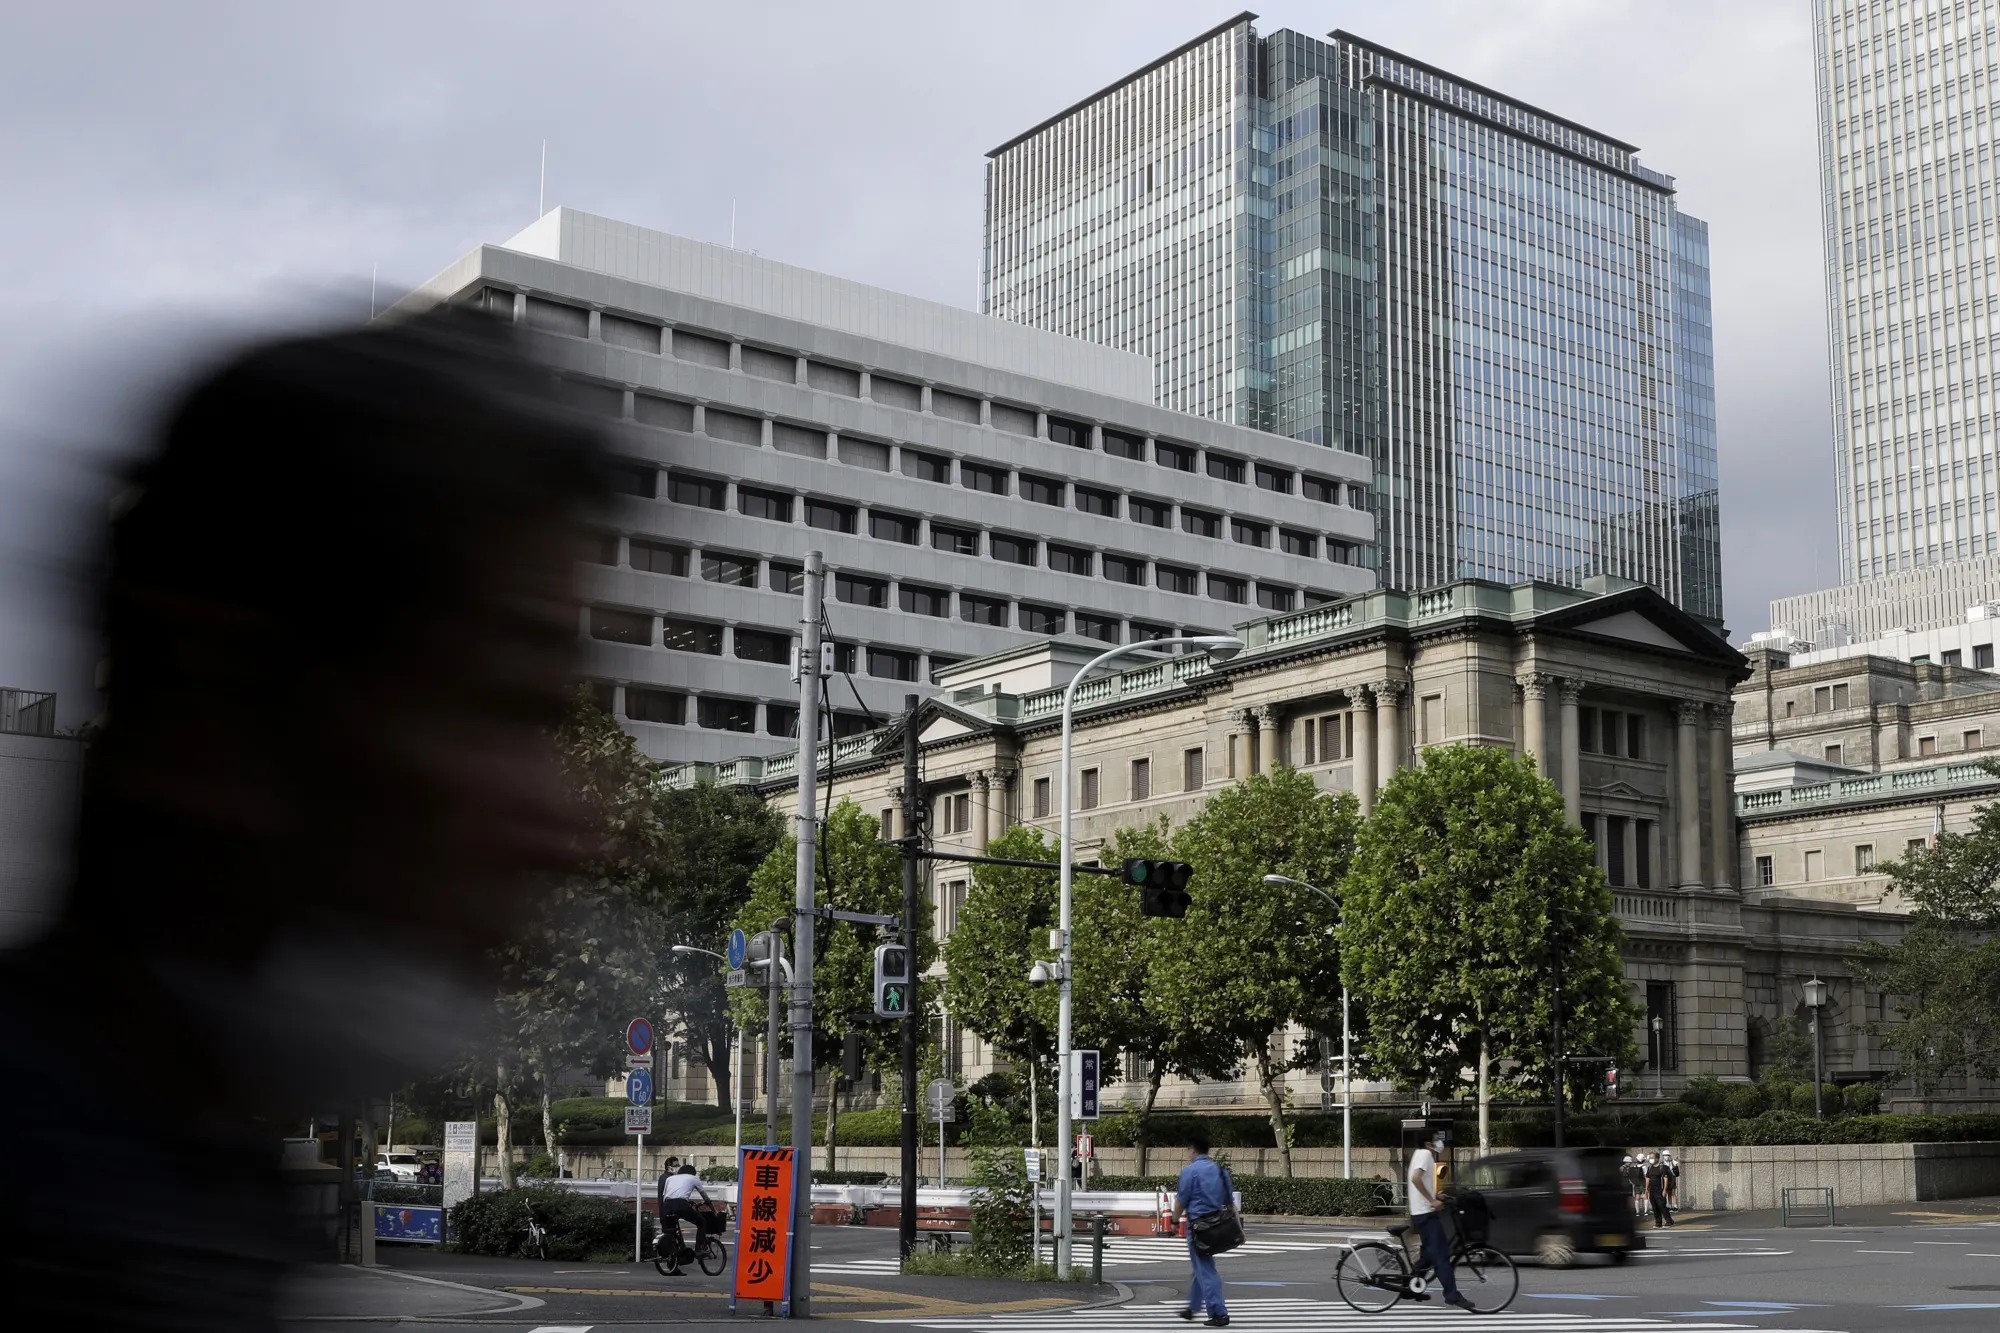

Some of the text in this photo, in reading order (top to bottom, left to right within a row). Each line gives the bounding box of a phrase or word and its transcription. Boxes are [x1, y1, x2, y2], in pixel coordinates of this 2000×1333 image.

[632, 1078, 643, 1101] P
[1084, 1059, 1094, 1111] 常盤橋
[747, 1164, 780, 1284] 車線減少
